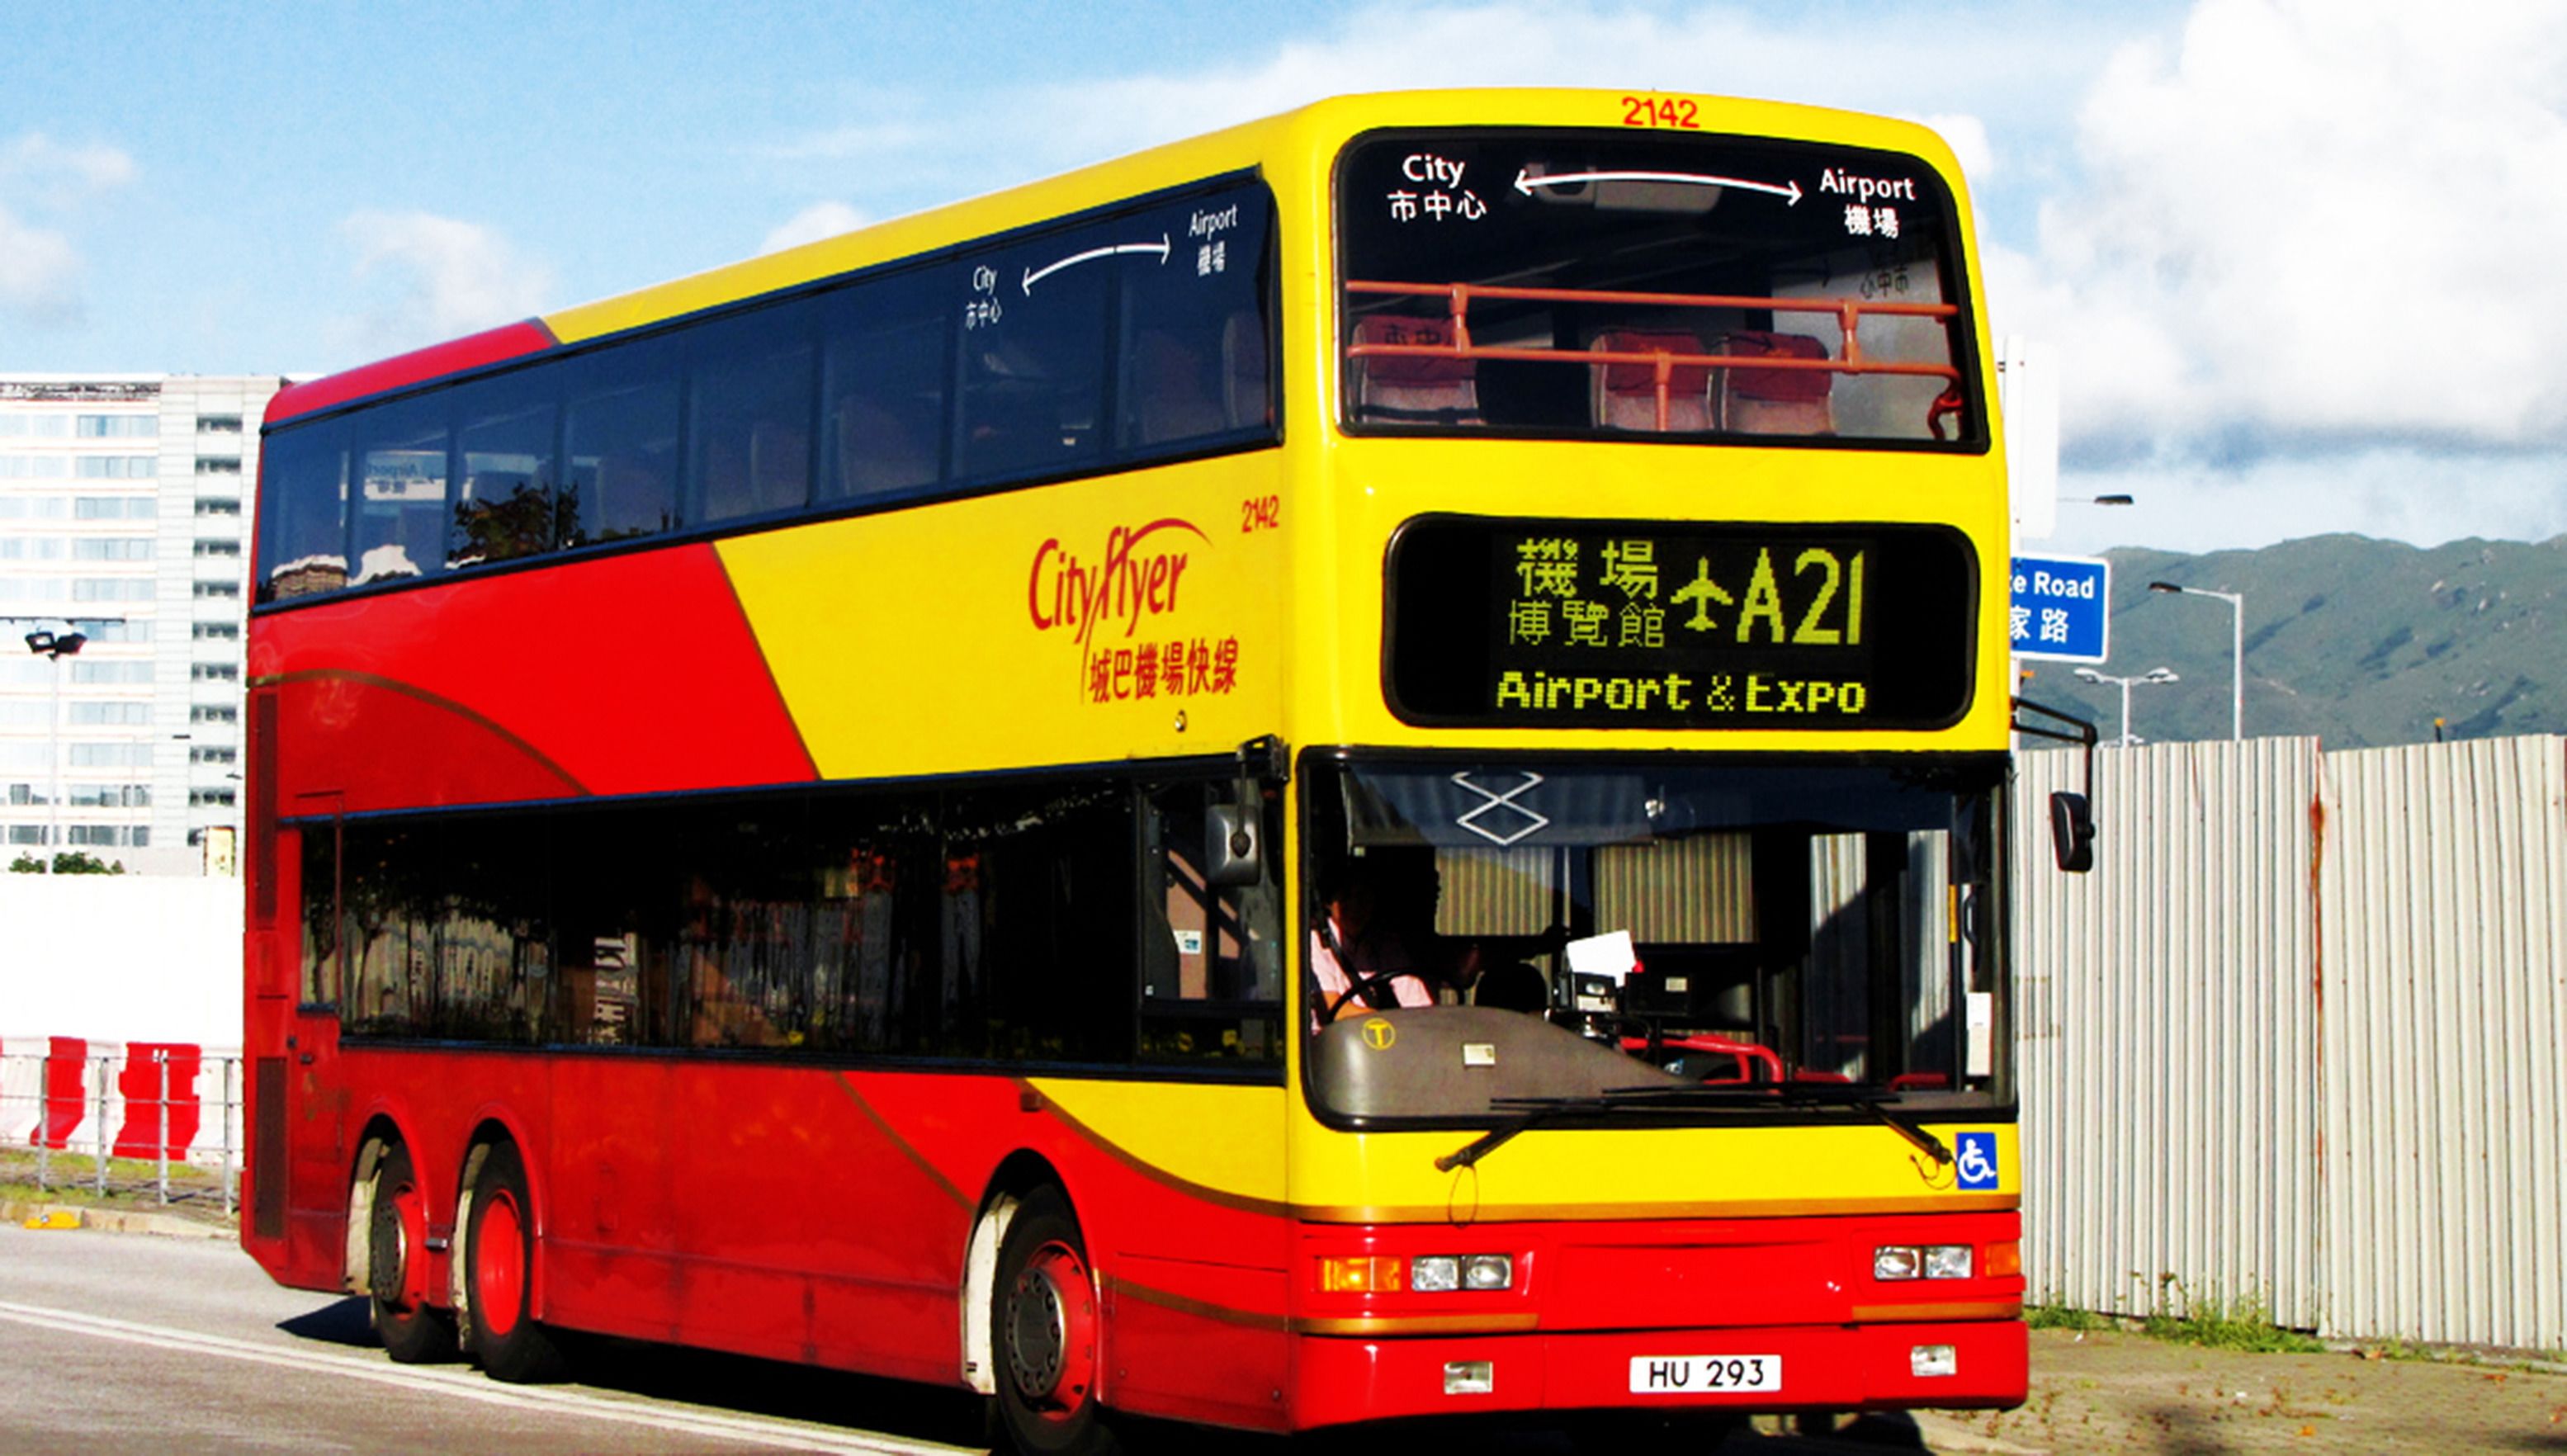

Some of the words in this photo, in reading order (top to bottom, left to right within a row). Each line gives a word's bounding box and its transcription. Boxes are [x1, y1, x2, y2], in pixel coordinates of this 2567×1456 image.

[1622, 97, 1700, 129] 2142
[1402, 154, 1465, 190] City
[1819, 168, 1915, 203] Airport
[1189, 205, 1237, 240] Airport
[1387, 191, 1487, 222] 市中心
[1844, 205, 1898, 238] 機場
[973, 265, 997, 295] City
[966, 297, 1002, 329] 市中心
[1241, 495, 1279, 533] 2142
[1028, 518, 1203, 645] Cityflyer
[1516, 538, 1658, 599] 機場
[2034, 570, 2095, 599] Road
[1737, 547, 1863, 646] A21
[1508, 600, 1665, 648] 博覽館
[1088, 636, 1239, 703] 城巴機場快線
[1497, 671, 1692, 711] Airport
[1707, 675, 1735, 712] &
[1746, 674, 1866, 713] Expo
[1650, 1362, 1689, 1387] HU
[1707, 1359, 1763, 1387] 293
